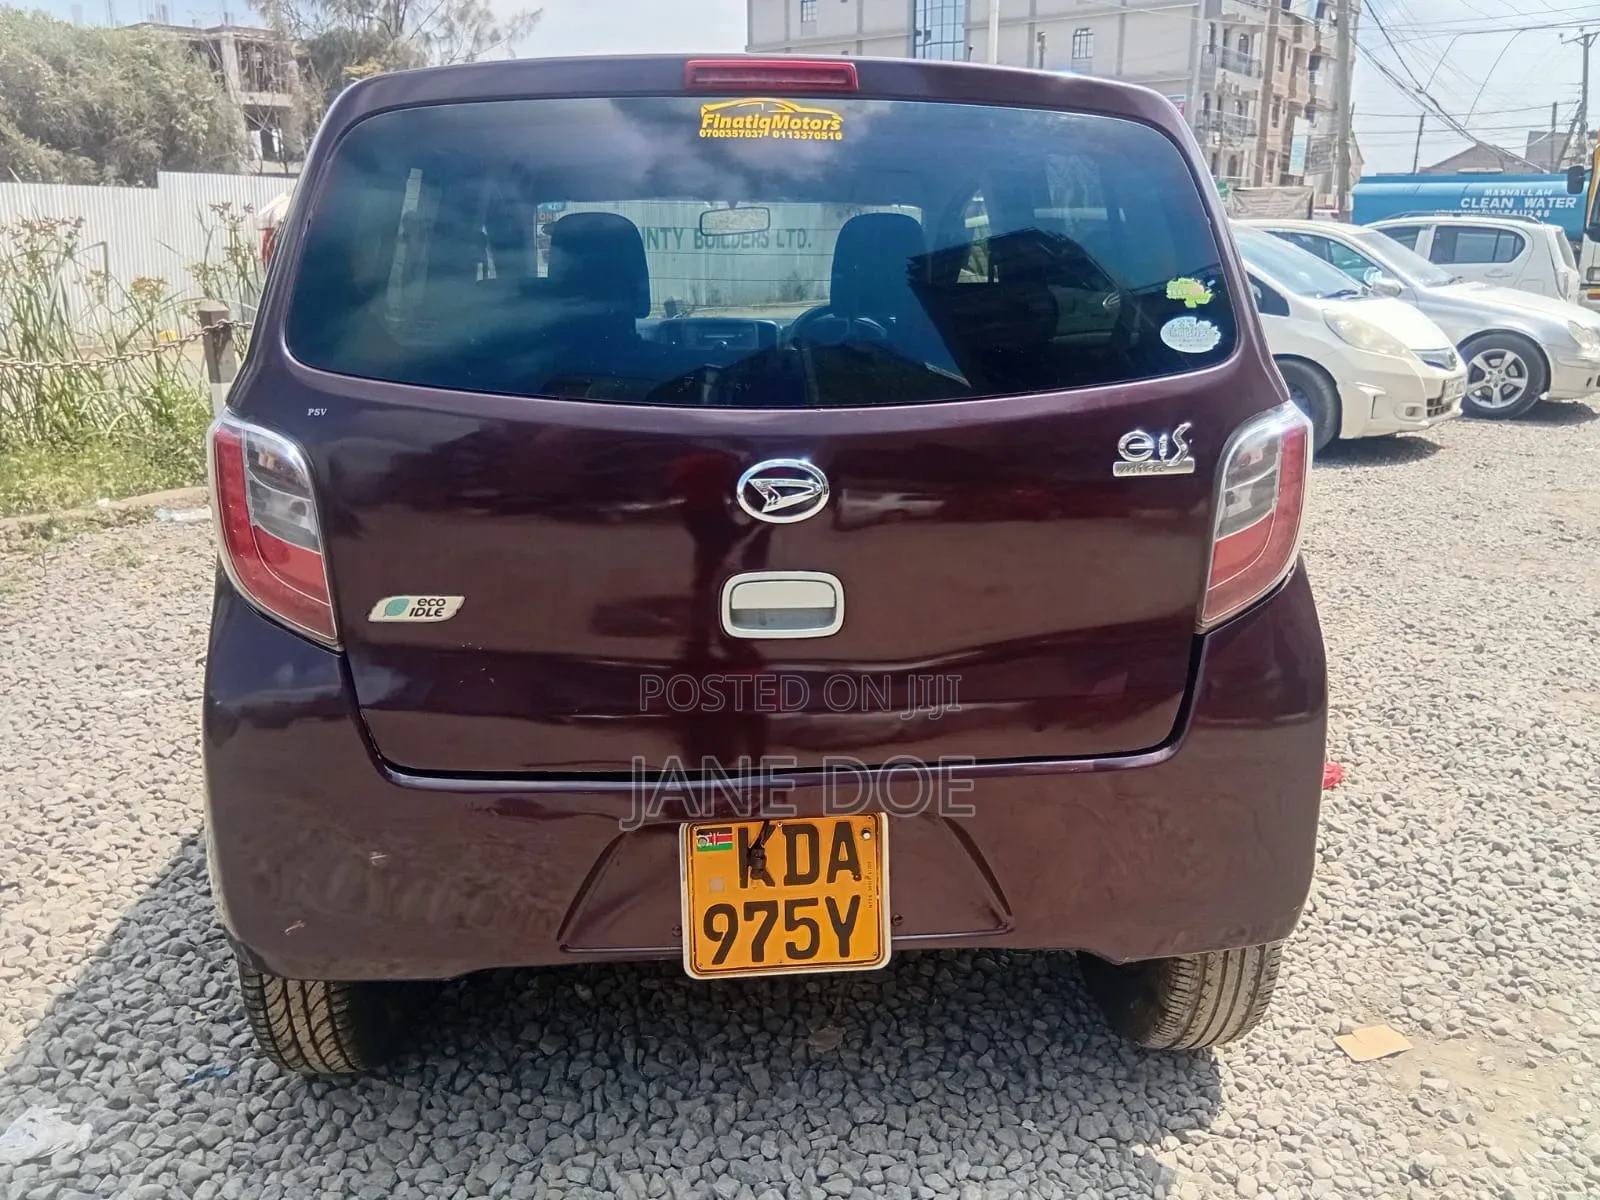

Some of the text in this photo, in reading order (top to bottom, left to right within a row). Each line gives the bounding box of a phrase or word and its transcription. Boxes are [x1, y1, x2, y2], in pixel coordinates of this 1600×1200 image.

[701, 114, 841, 136] FinatiqMotors
[699, 129, 843, 140] 0700357037 0113370510
[1460, 197, 1577, 209] CLEAN WATER
[642, 227, 812, 250] NTY BUILDERS LTD.
[307, 408, 328, 416] PSV
[417, 598, 446, 607] eco
[408, 607, 445, 617] IDLE
[737, 821, 863, 889] KDA
[703, 894, 861, 965] 975Y
